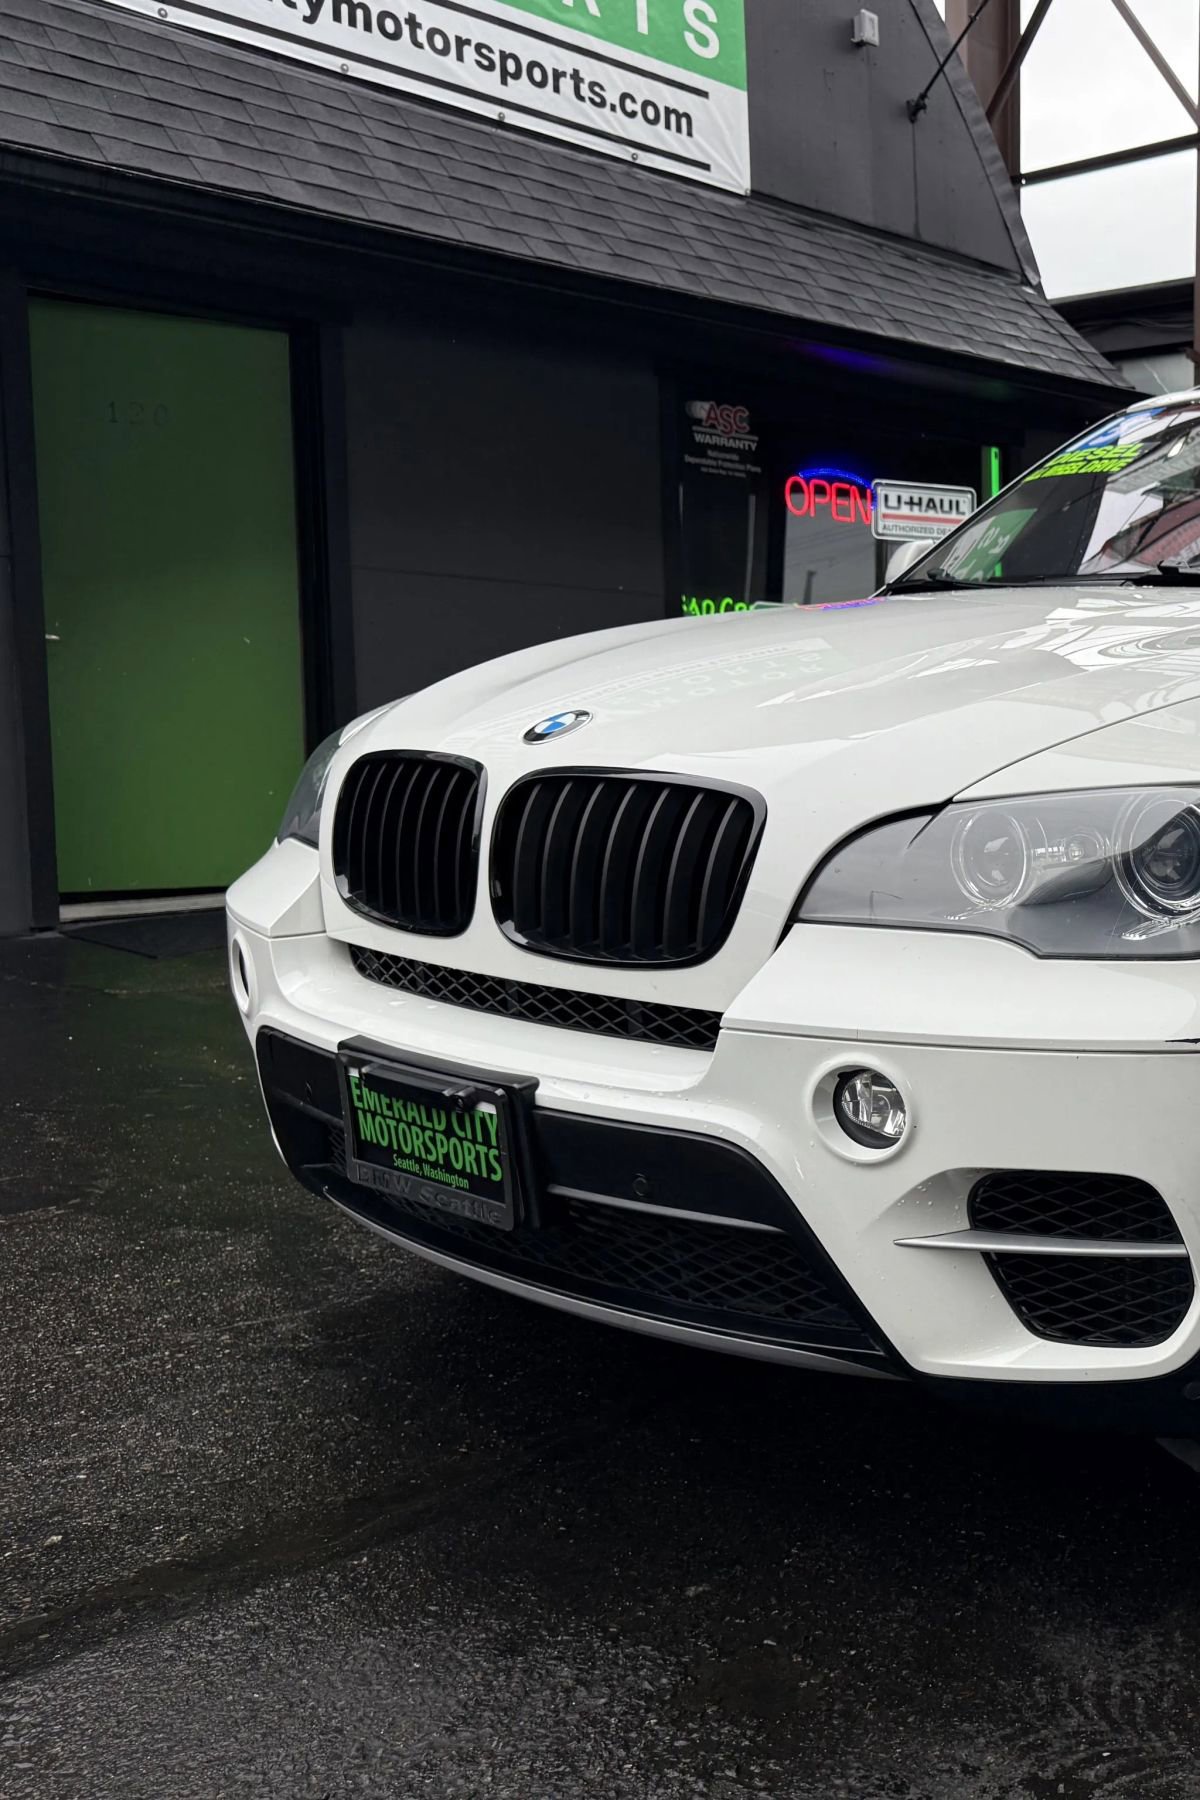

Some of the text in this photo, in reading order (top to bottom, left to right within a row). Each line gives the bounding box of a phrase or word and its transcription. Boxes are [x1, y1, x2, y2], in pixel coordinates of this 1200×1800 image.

[282, 0, 694, 138] ymotorsports.com
[702, 401, 750, 438] ASC
[694, 432, 757, 451] WARRANTY
[1043, 442, 1144, 470] DIESEL
[784, 475, 871, 526] OPEN
[884, 493, 967, 516] U-HAUL
[882, 523, 935, 536] AUTHORIZED
[350, 1076, 498, 1147] EMERALD CITY
[357, 1110, 503, 1182] MOTORSPORTS
[393, 1153, 470, 1190] Seattle, Washington
[419, 1185, 504, 1225] Seattle
